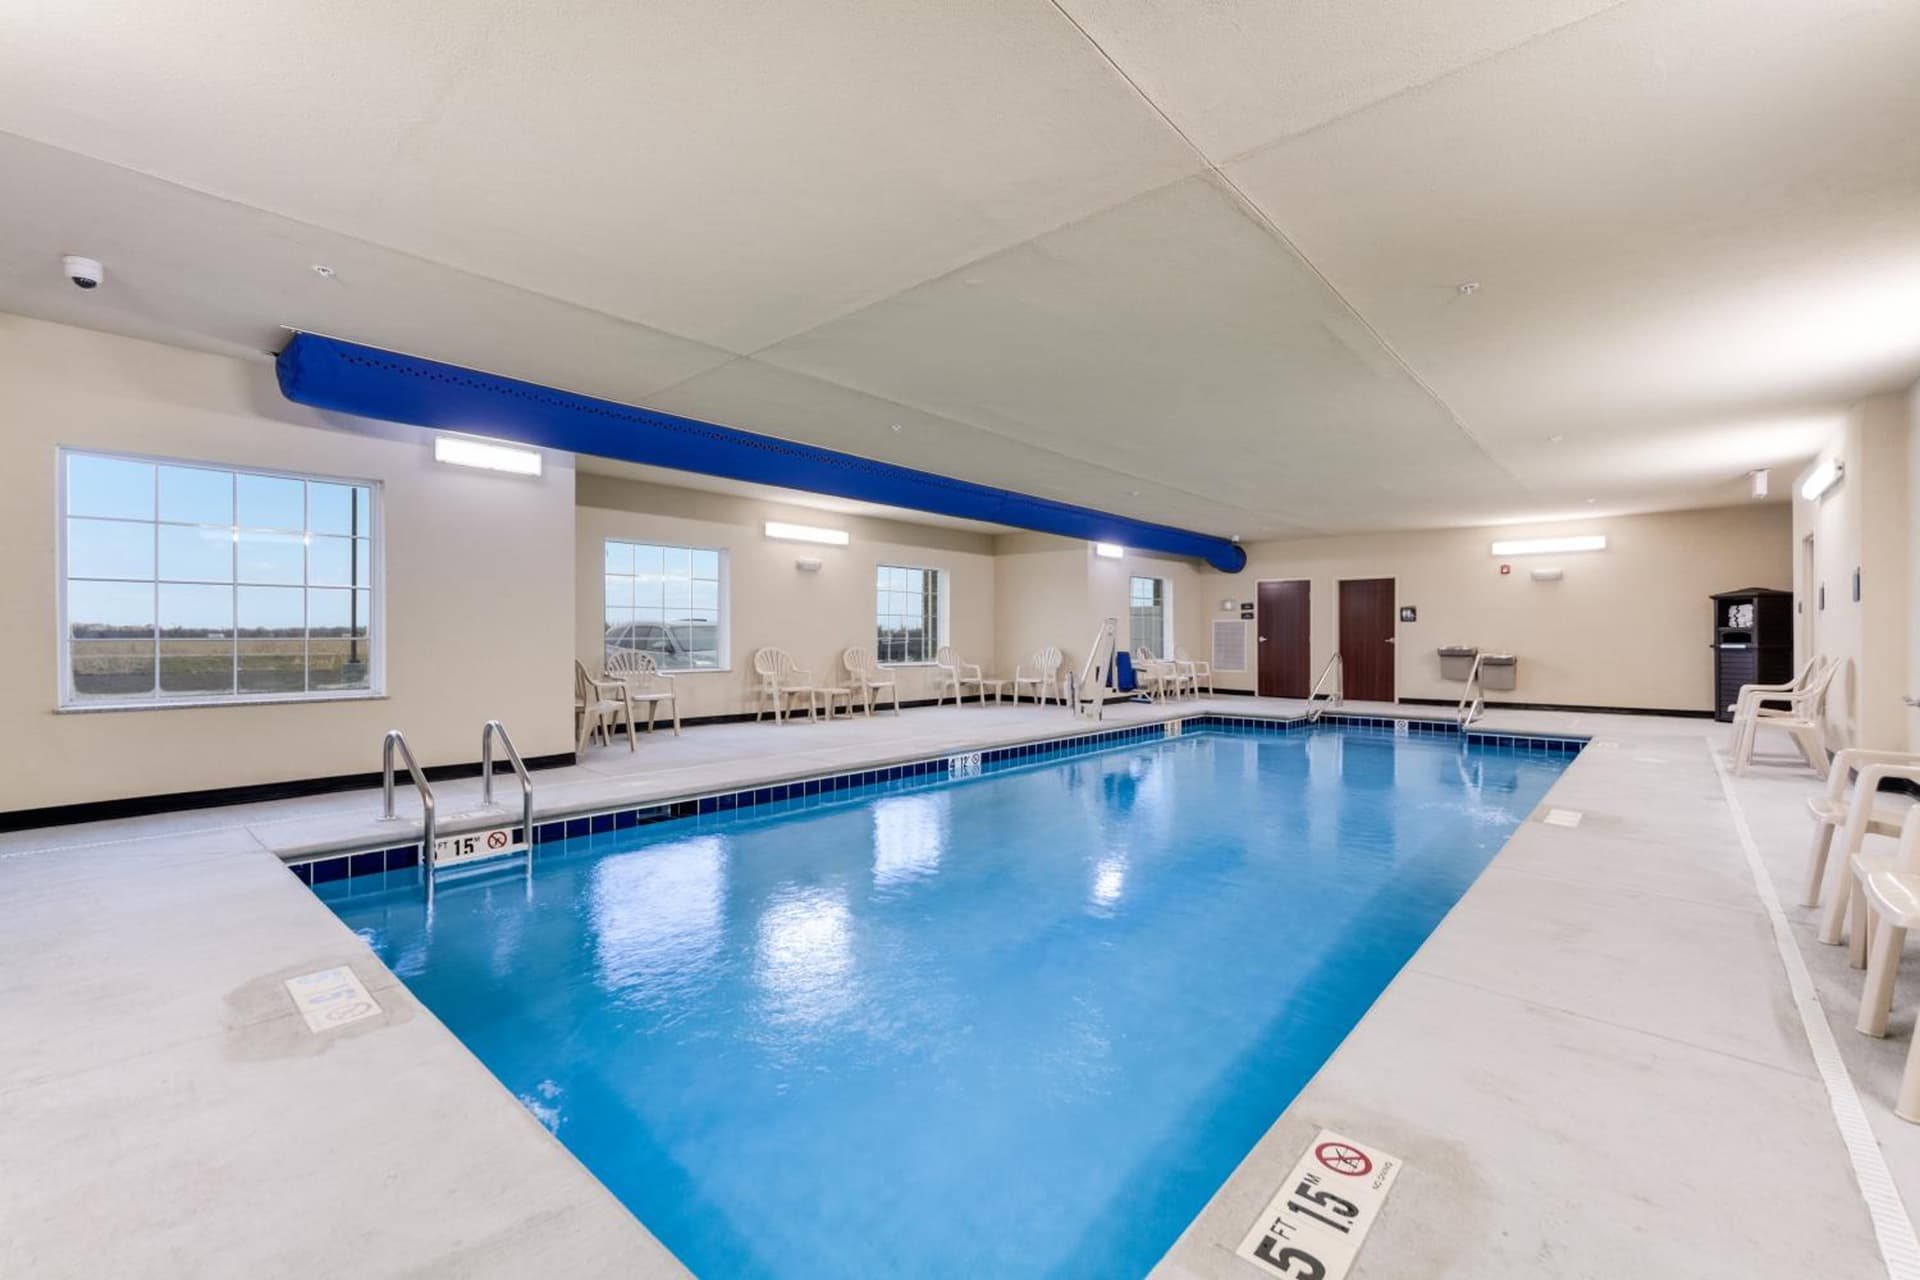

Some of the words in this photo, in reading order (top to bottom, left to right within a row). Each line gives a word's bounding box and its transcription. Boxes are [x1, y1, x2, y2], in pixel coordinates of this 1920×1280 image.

[1304, 1172, 1322, 1185] M
[1270, 1217, 1297, 1240] FT
[1253, 1235, 1326, 1280] 5
